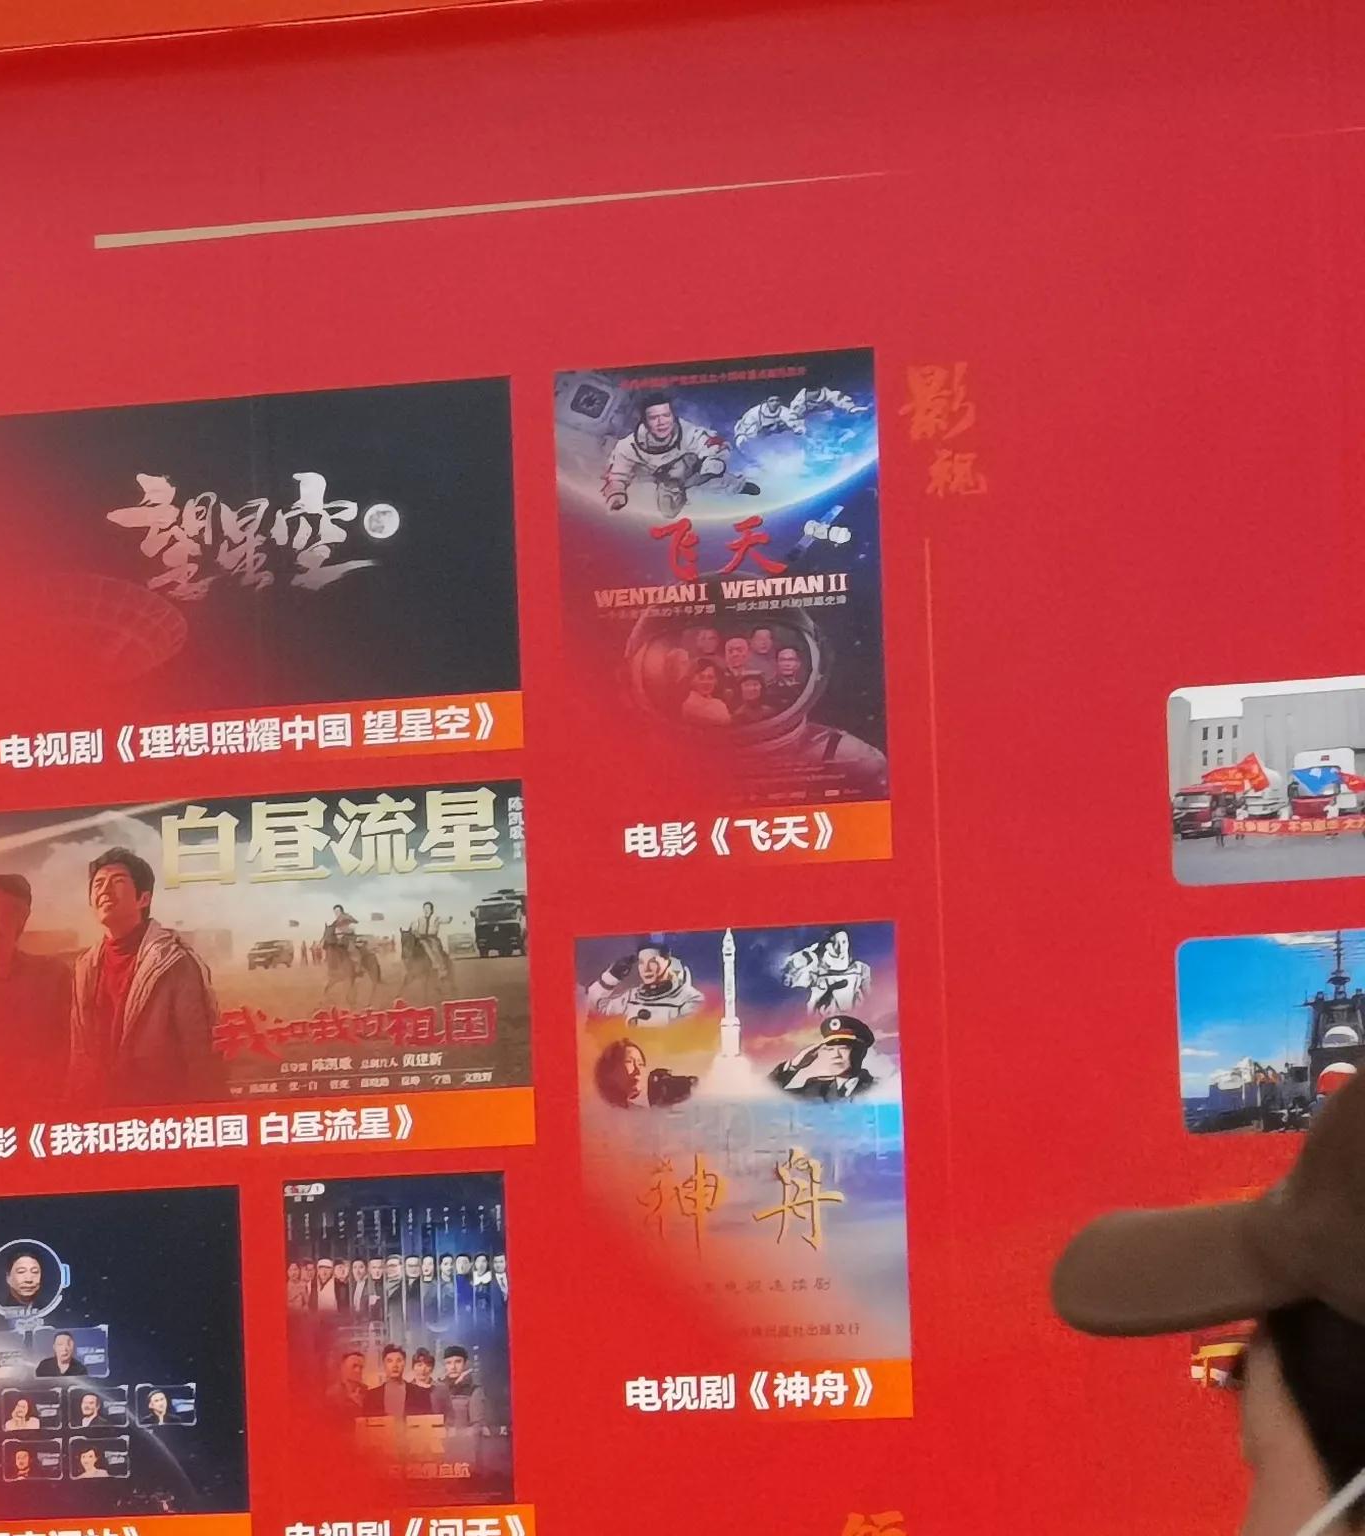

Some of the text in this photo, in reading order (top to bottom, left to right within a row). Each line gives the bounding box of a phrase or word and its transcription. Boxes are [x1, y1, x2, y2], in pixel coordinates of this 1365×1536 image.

[106, 471, 377, 601] 望星空
[650, 515, 790, 584] 飞天
[594, 584, 696, 608] WENTIAN
[720, 575, 824, 600] WENTIAN
[362, 702, 495, 746] 望星空》
[159, 785, 507, 890] 白昼流星
[623, 810, 837, 859] 电影《飞天》
[260, 1104, 416, 1145] 白昼流星》
[625, 1370, 874, 1412] 电视剧《神舟》
